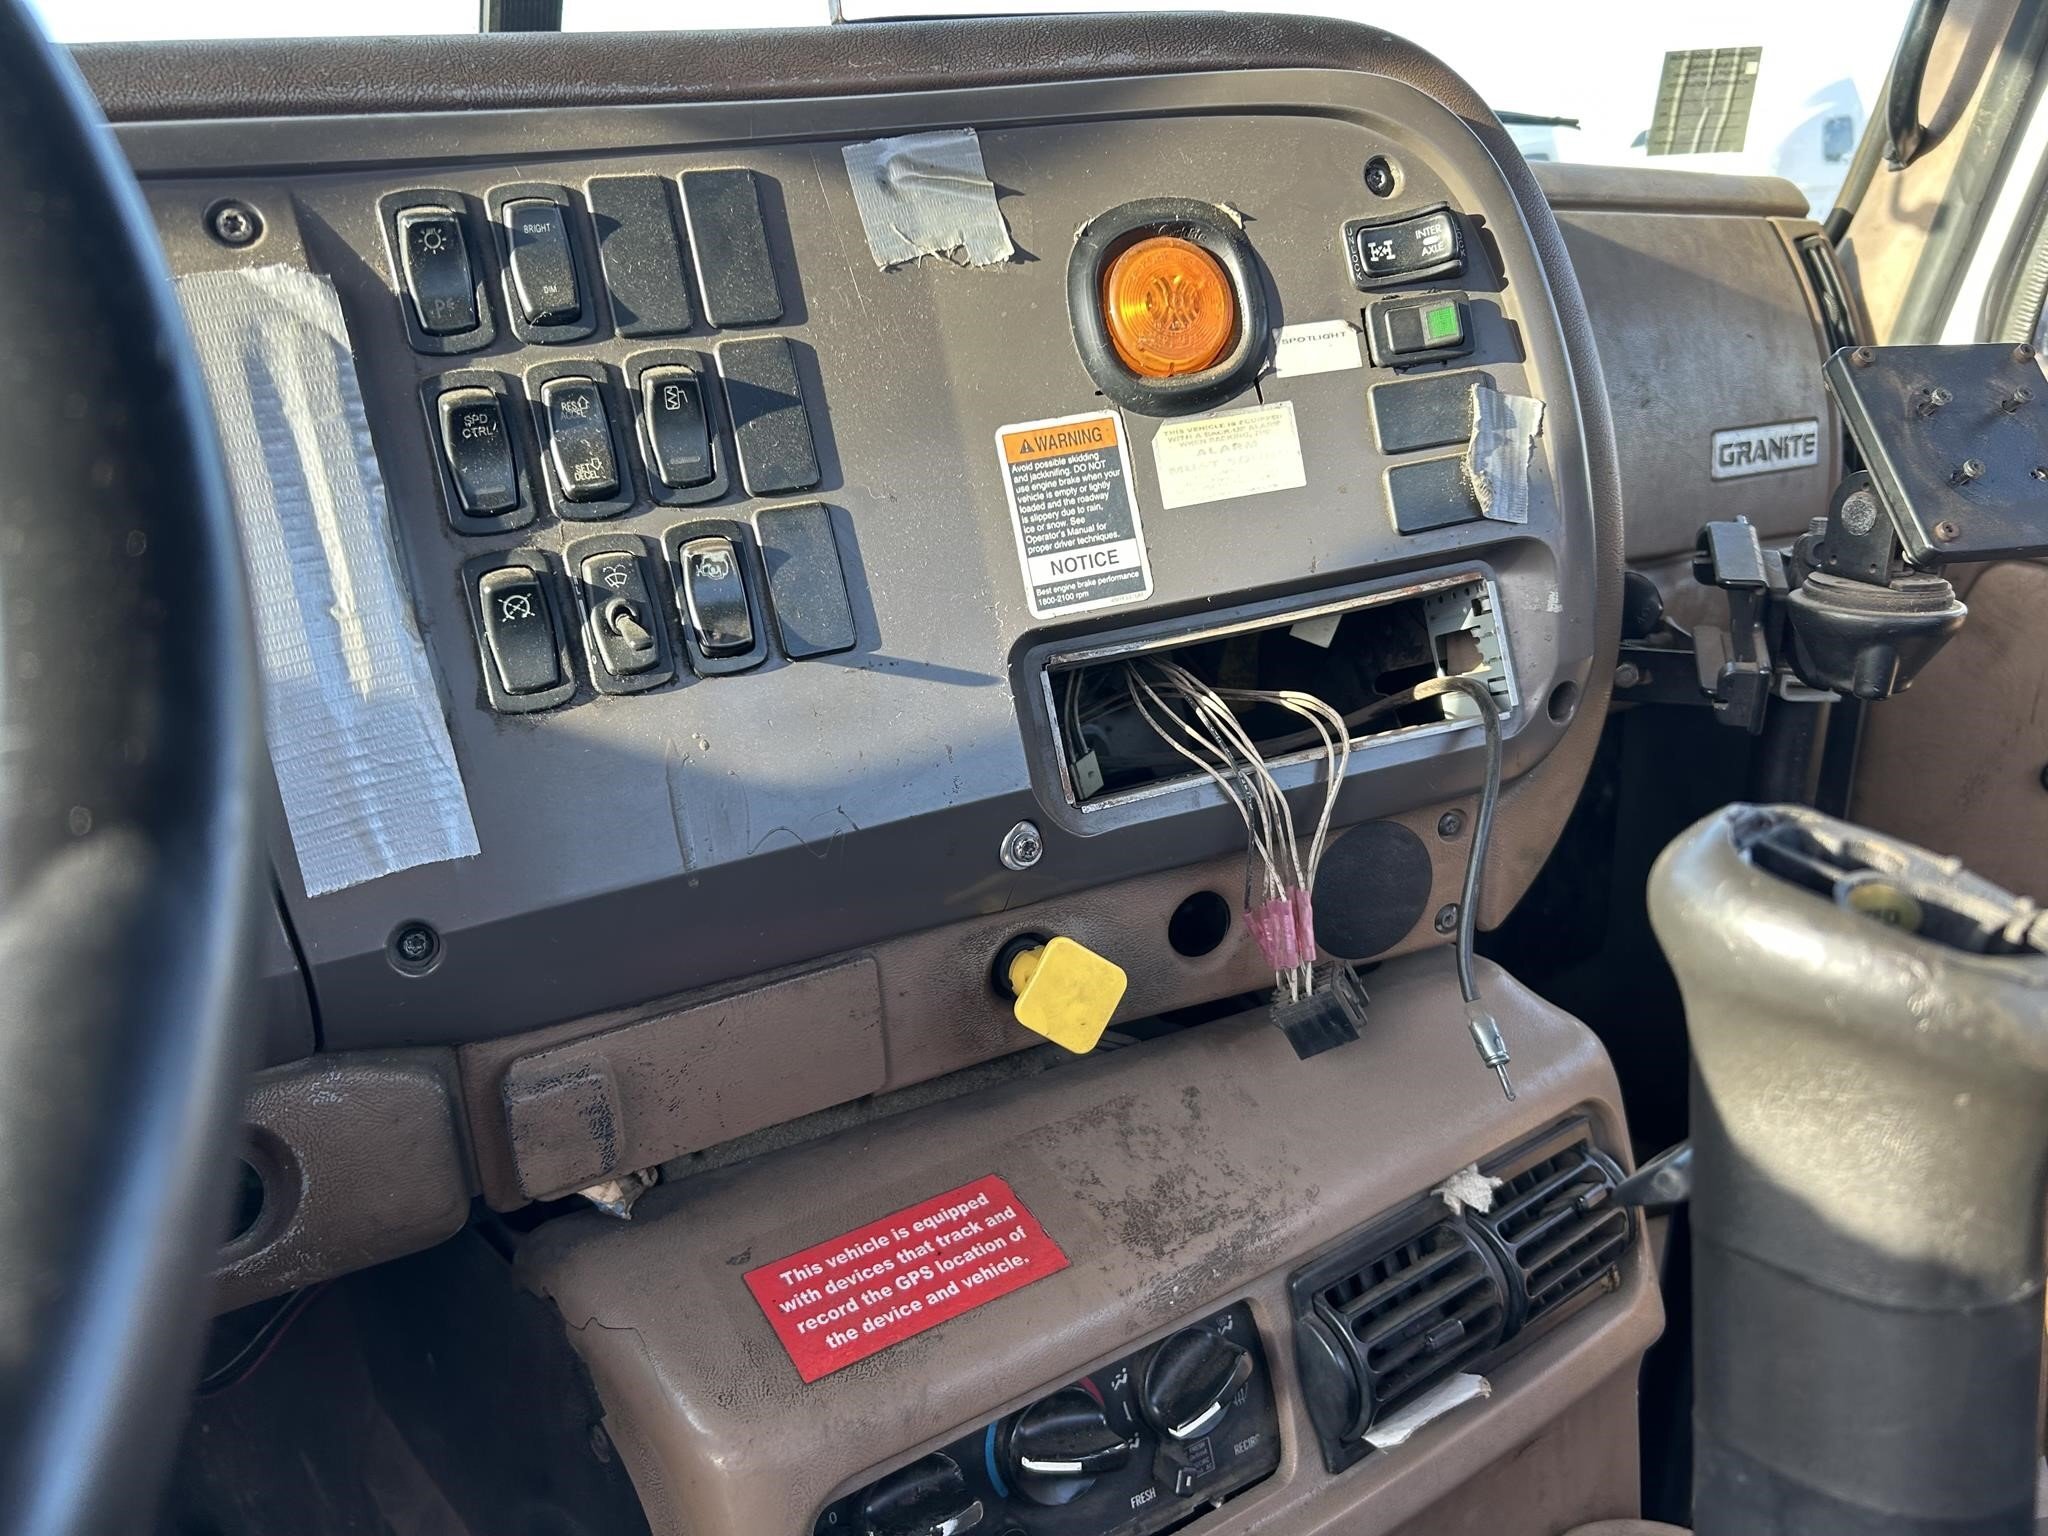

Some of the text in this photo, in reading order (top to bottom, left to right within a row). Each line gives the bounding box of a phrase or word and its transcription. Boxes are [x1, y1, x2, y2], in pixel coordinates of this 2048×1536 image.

[523, 223, 551, 234] BRIGHT
[1415, 224, 1442, 240] INTER
[1422, 242, 1445, 257] AXLE
[1282, 331, 1345, 345] SPOTLIGHT
[561, 401, 578, 411] RES
[463, 414, 489, 427] SPD
[462, 426, 494, 439] CTRL
[1034, 426, 1103, 452] WARNING
[1163, 429, 1184, 437] THIS
[1720, 433, 1815, 467] GRANITE
[574, 463, 591, 474] SET
[1011, 452, 1099, 474] Avoid possible skidding
[1013, 460, 1107, 484] and jackknifing. DO NOT
[574, 471, 600, 481] DECEL
[1016, 468, 1121, 494] use engine brake when your
[1017, 481, 1111, 503] vehicle is empty or lightly
[1019, 491, 1109, 514] loaded and the roadway
[1021, 515, 1029, 524] is
[1030, 509, 1060, 522] slippery
[1061, 506, 1076, 517] due
[1077, 505, 1085, 514] to
[1023, 524, 1035, 534] ice
[1036, 522, 1044, 531] or
[1070, 516, 1086, 526] See
[1025, 522, 1107, 545] Operator's Manual for
[1027, 531, 1121, 556] proper driver techniques.
[1050, 549, 1120, 576] NOTICE
[1036, 571, 1140, 597] Best engine brake performance
[1038, 590, 1090, 606] 1800-2100 rpm
[779, 1192, 989, 1287] This vehicle is equipped
[779, 1205, 1017, 1314] with devices that track and
[796, 1225, 1028, 1335] record the GPS location of
[825, 1254, 1030, 1350] the device and vehicle.
[1130, 1486, 1157, 1509] FRESH
